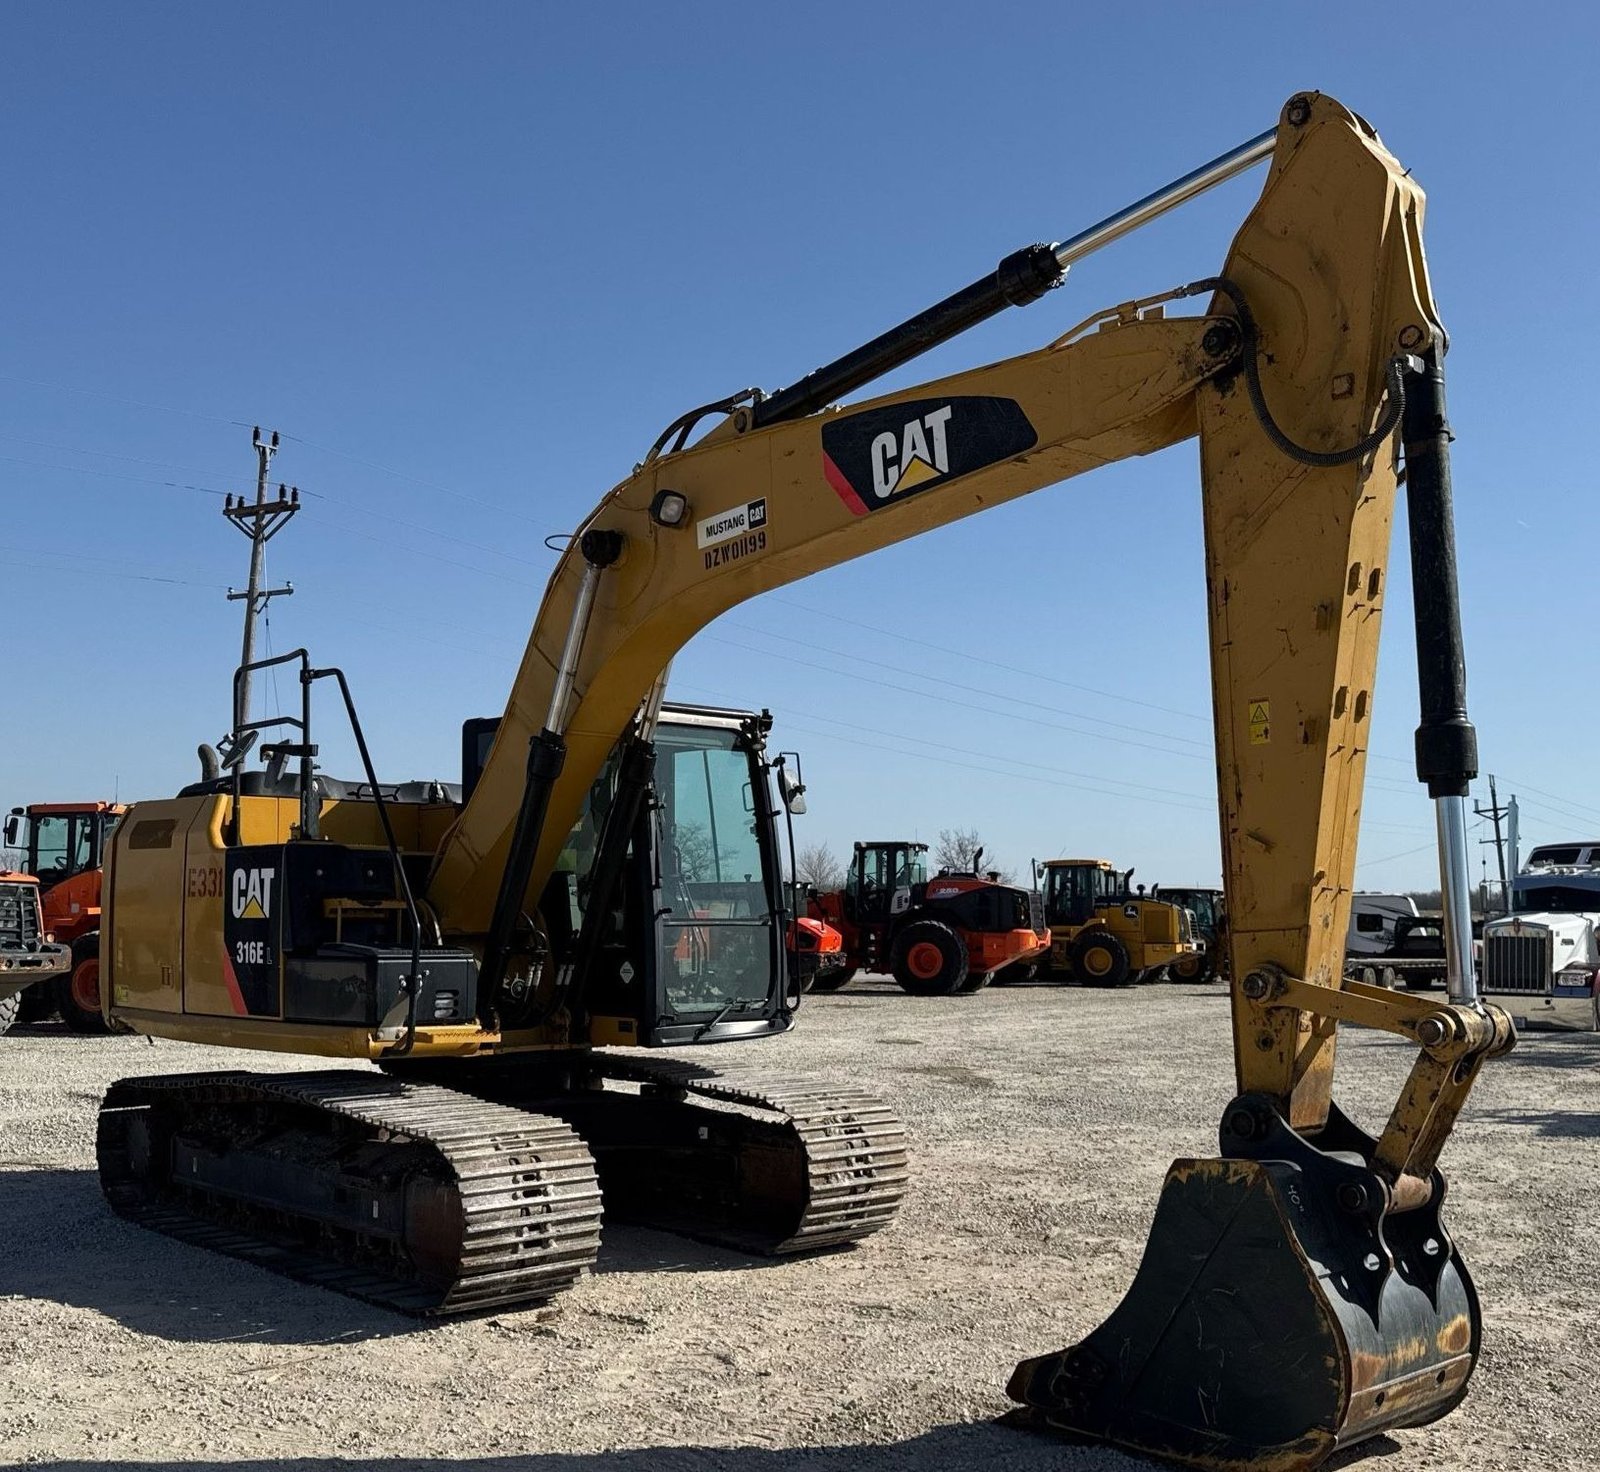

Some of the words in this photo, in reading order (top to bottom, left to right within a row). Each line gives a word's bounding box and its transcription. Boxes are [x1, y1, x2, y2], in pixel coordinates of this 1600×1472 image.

[871, 405, 952, 498] CAT
[705, 514, 745, 538] MUSTANG
[749, 505, 765, 522] CAT
[188, 867, 223, 897] E331
[232, 868, 275, 918] CAT
[236, 941, 264, 964] 316E
